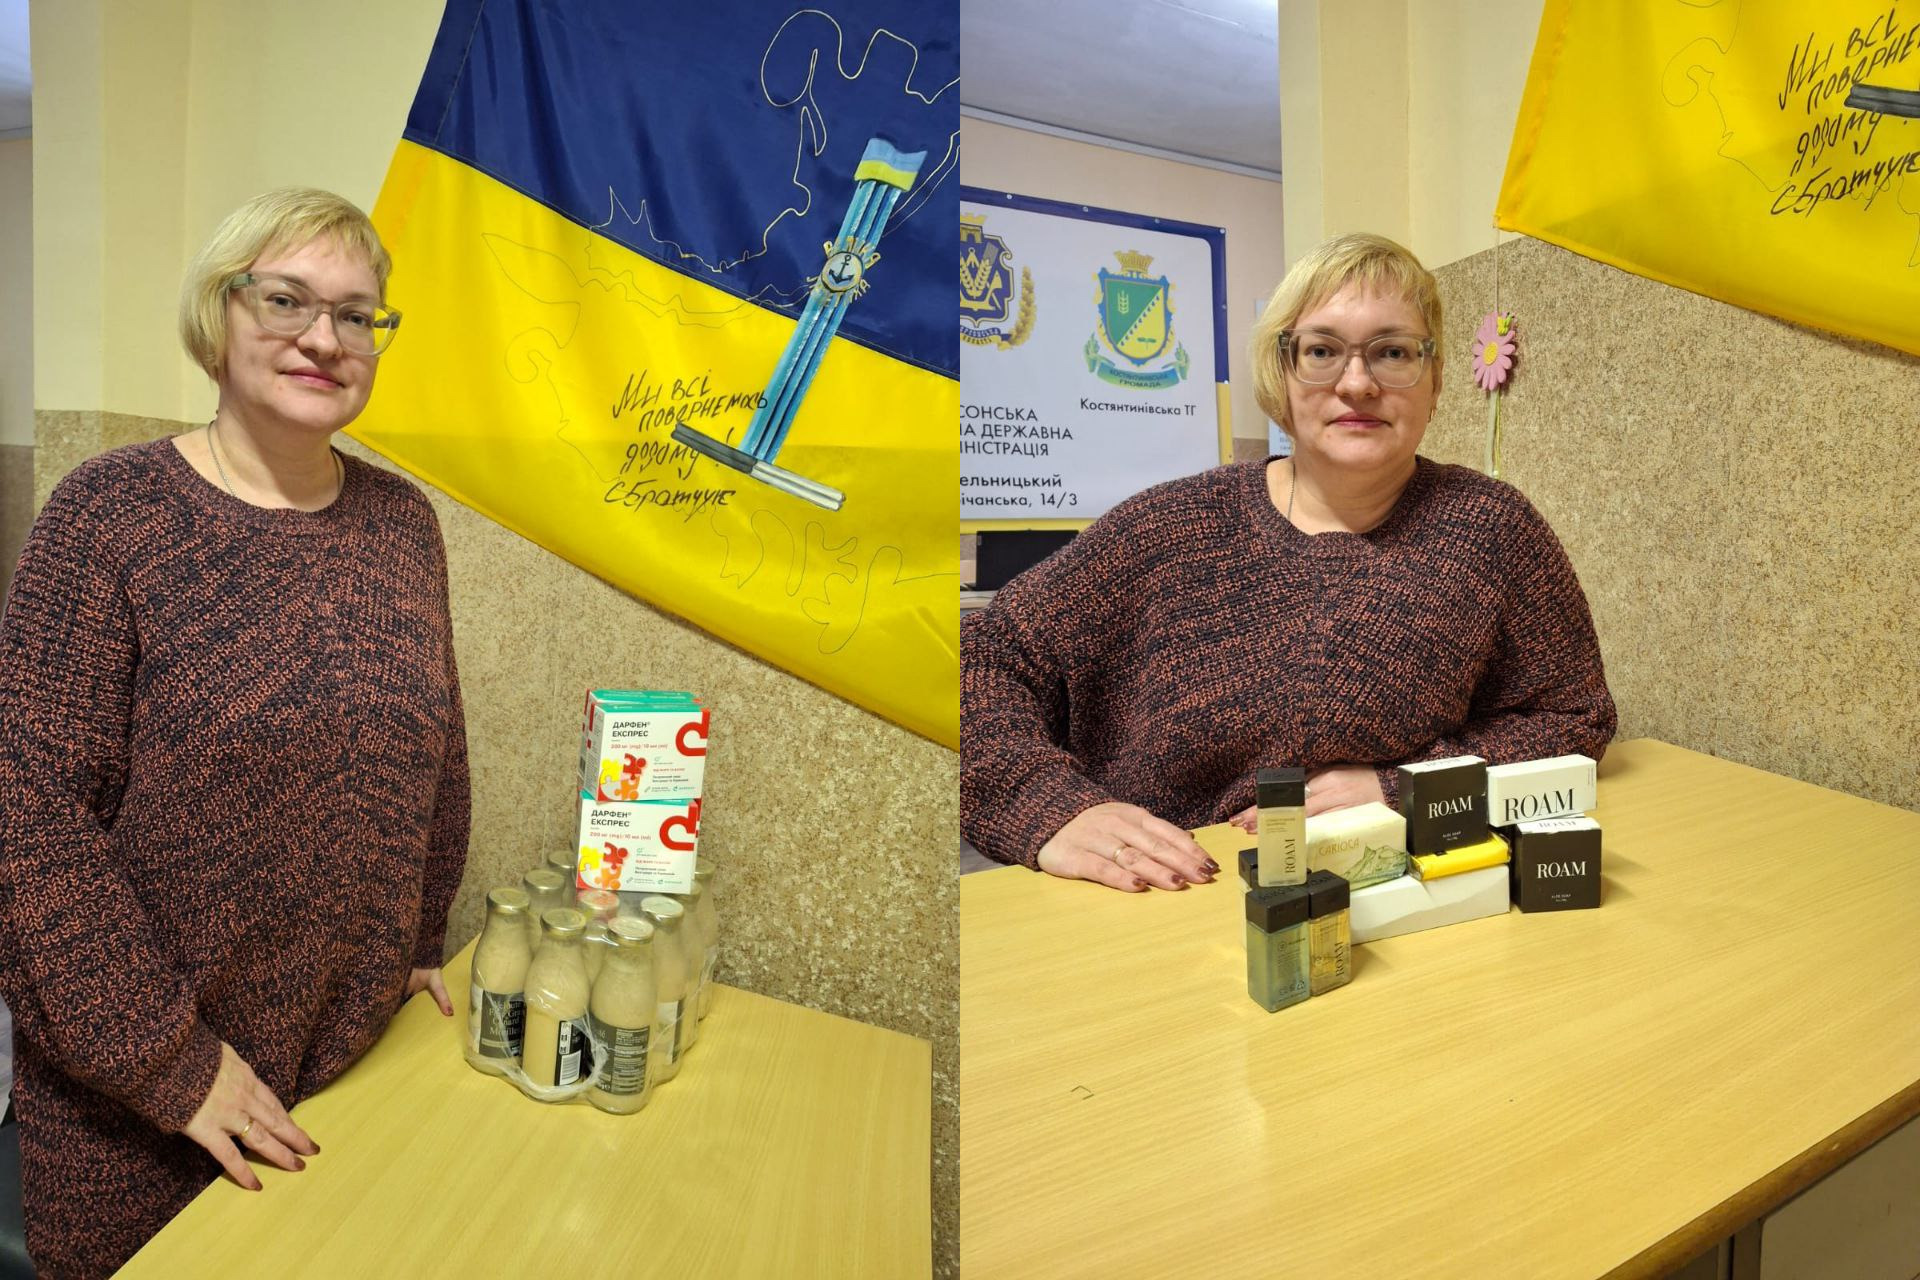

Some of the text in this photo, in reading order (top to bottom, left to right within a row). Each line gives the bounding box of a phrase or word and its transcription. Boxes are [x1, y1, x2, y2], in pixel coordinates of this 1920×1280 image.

[1080, 398, 1181, 416] Костянтинівська
[980, 423, 1074, 440] ДЕРЖАВНА
[960, 440, 1050, 458] НІСТРАЦІЯ
[1041, 491, 1078, 509] 14/3
[1428, 795, 1473, 819] ROAM
[1503, 788, 1575, 822] ROAM
[591, 819, 630, 827] ЕКСПРЕС
[1285, 839, 1295, 873] ROAM
[1319, 837, 1360, 857] CARIOCA
[1537, 861, 1588, 879] ROAM
[1335, 942, 1345, 977] ROAM
